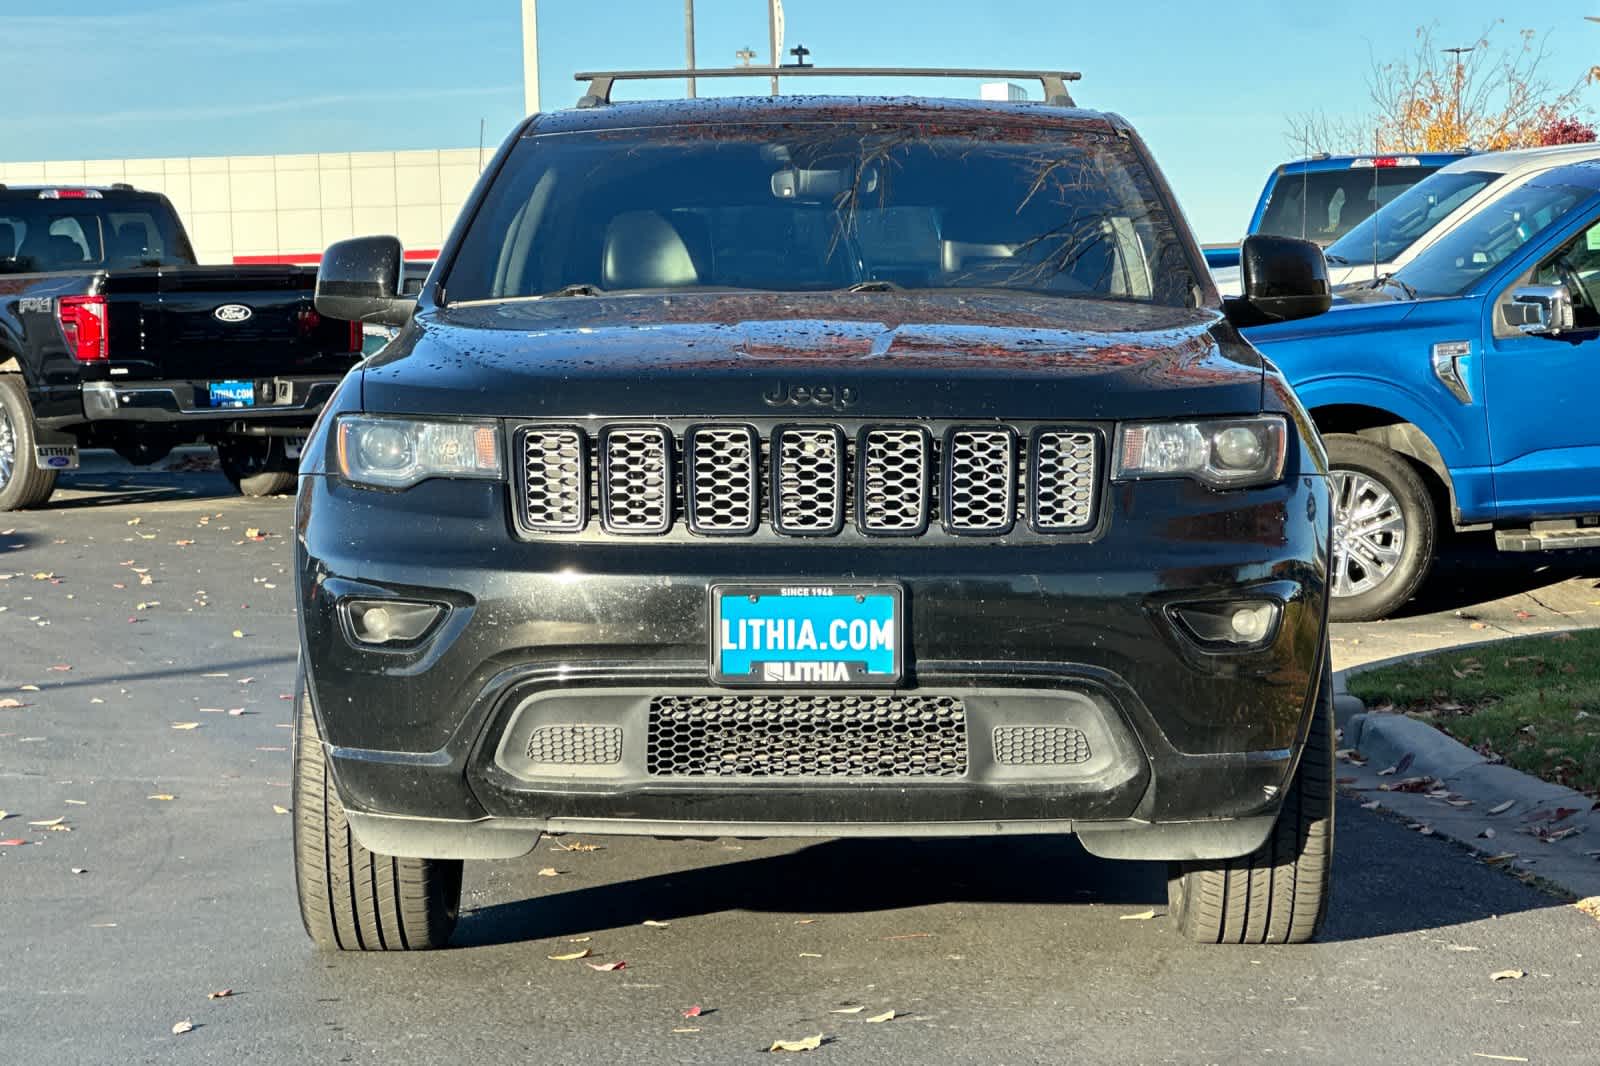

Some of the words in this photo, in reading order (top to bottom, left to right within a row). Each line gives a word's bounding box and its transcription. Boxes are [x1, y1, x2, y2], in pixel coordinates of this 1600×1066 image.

[209, 388, 254, 400] LITHIA.COM
[762, 380, 858, 411] Jeep
[37, 447, 77, 457] LITHIA
[781, 587, 809, 597] SINCE
[721, 618, 894, 651] LITHIA.COM
[783, 661, 850, 682] LITHIA
